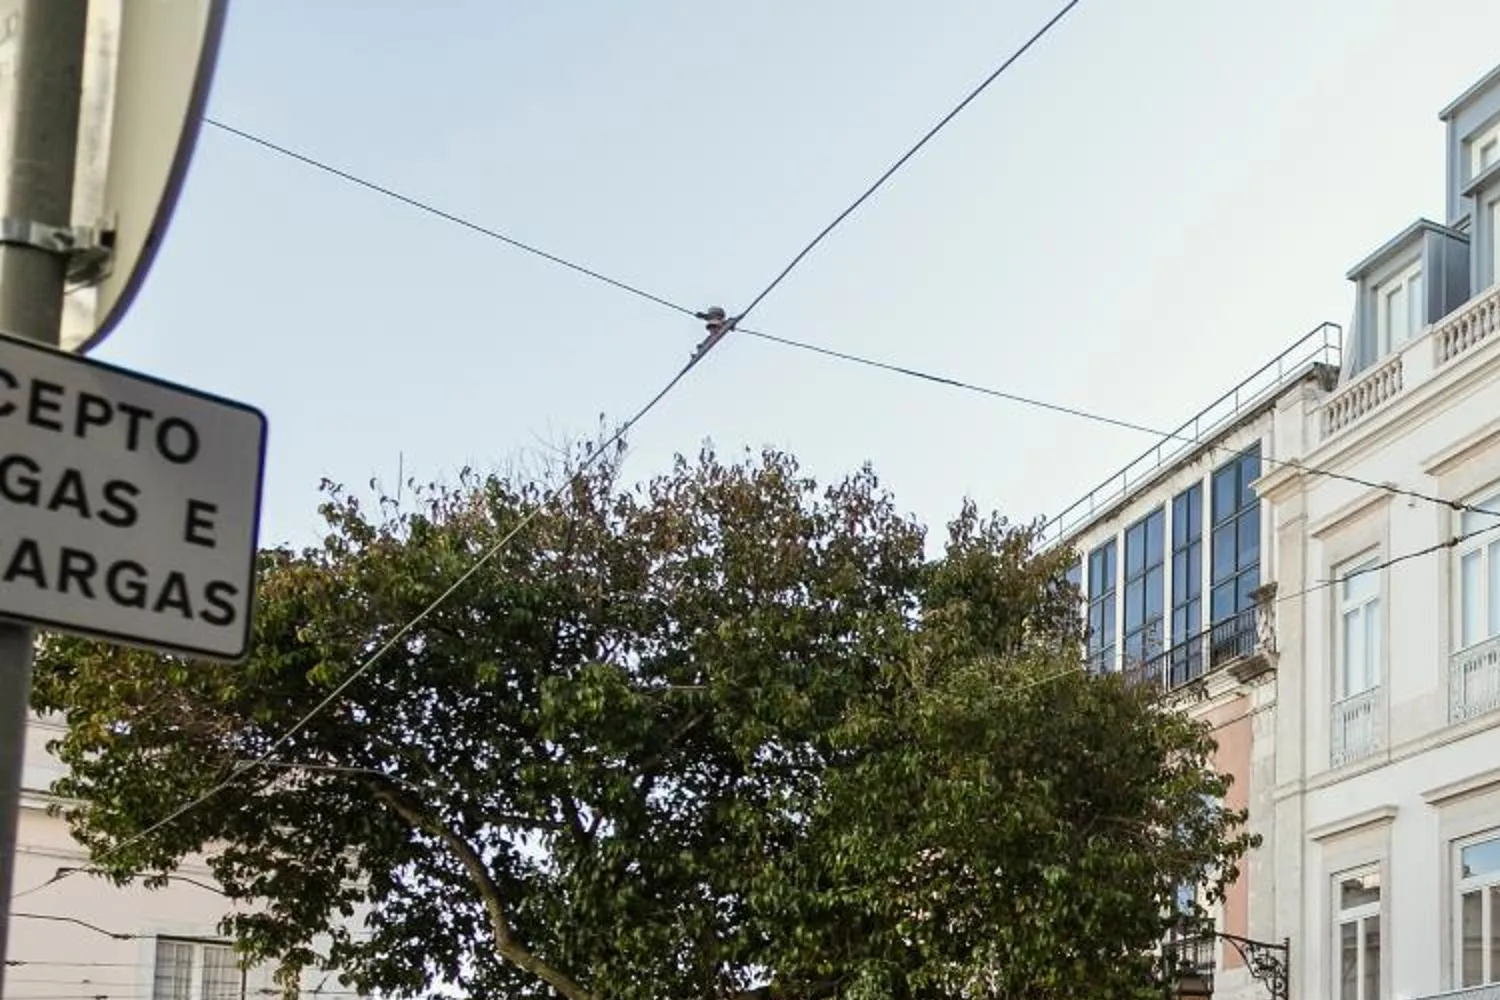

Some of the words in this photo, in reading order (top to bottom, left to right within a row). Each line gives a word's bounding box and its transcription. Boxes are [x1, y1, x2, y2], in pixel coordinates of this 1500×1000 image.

[1, 453, 142, 528] GAS
[184, 498, 217, 548] E
[3, 538, 240, 627] ARGAS
